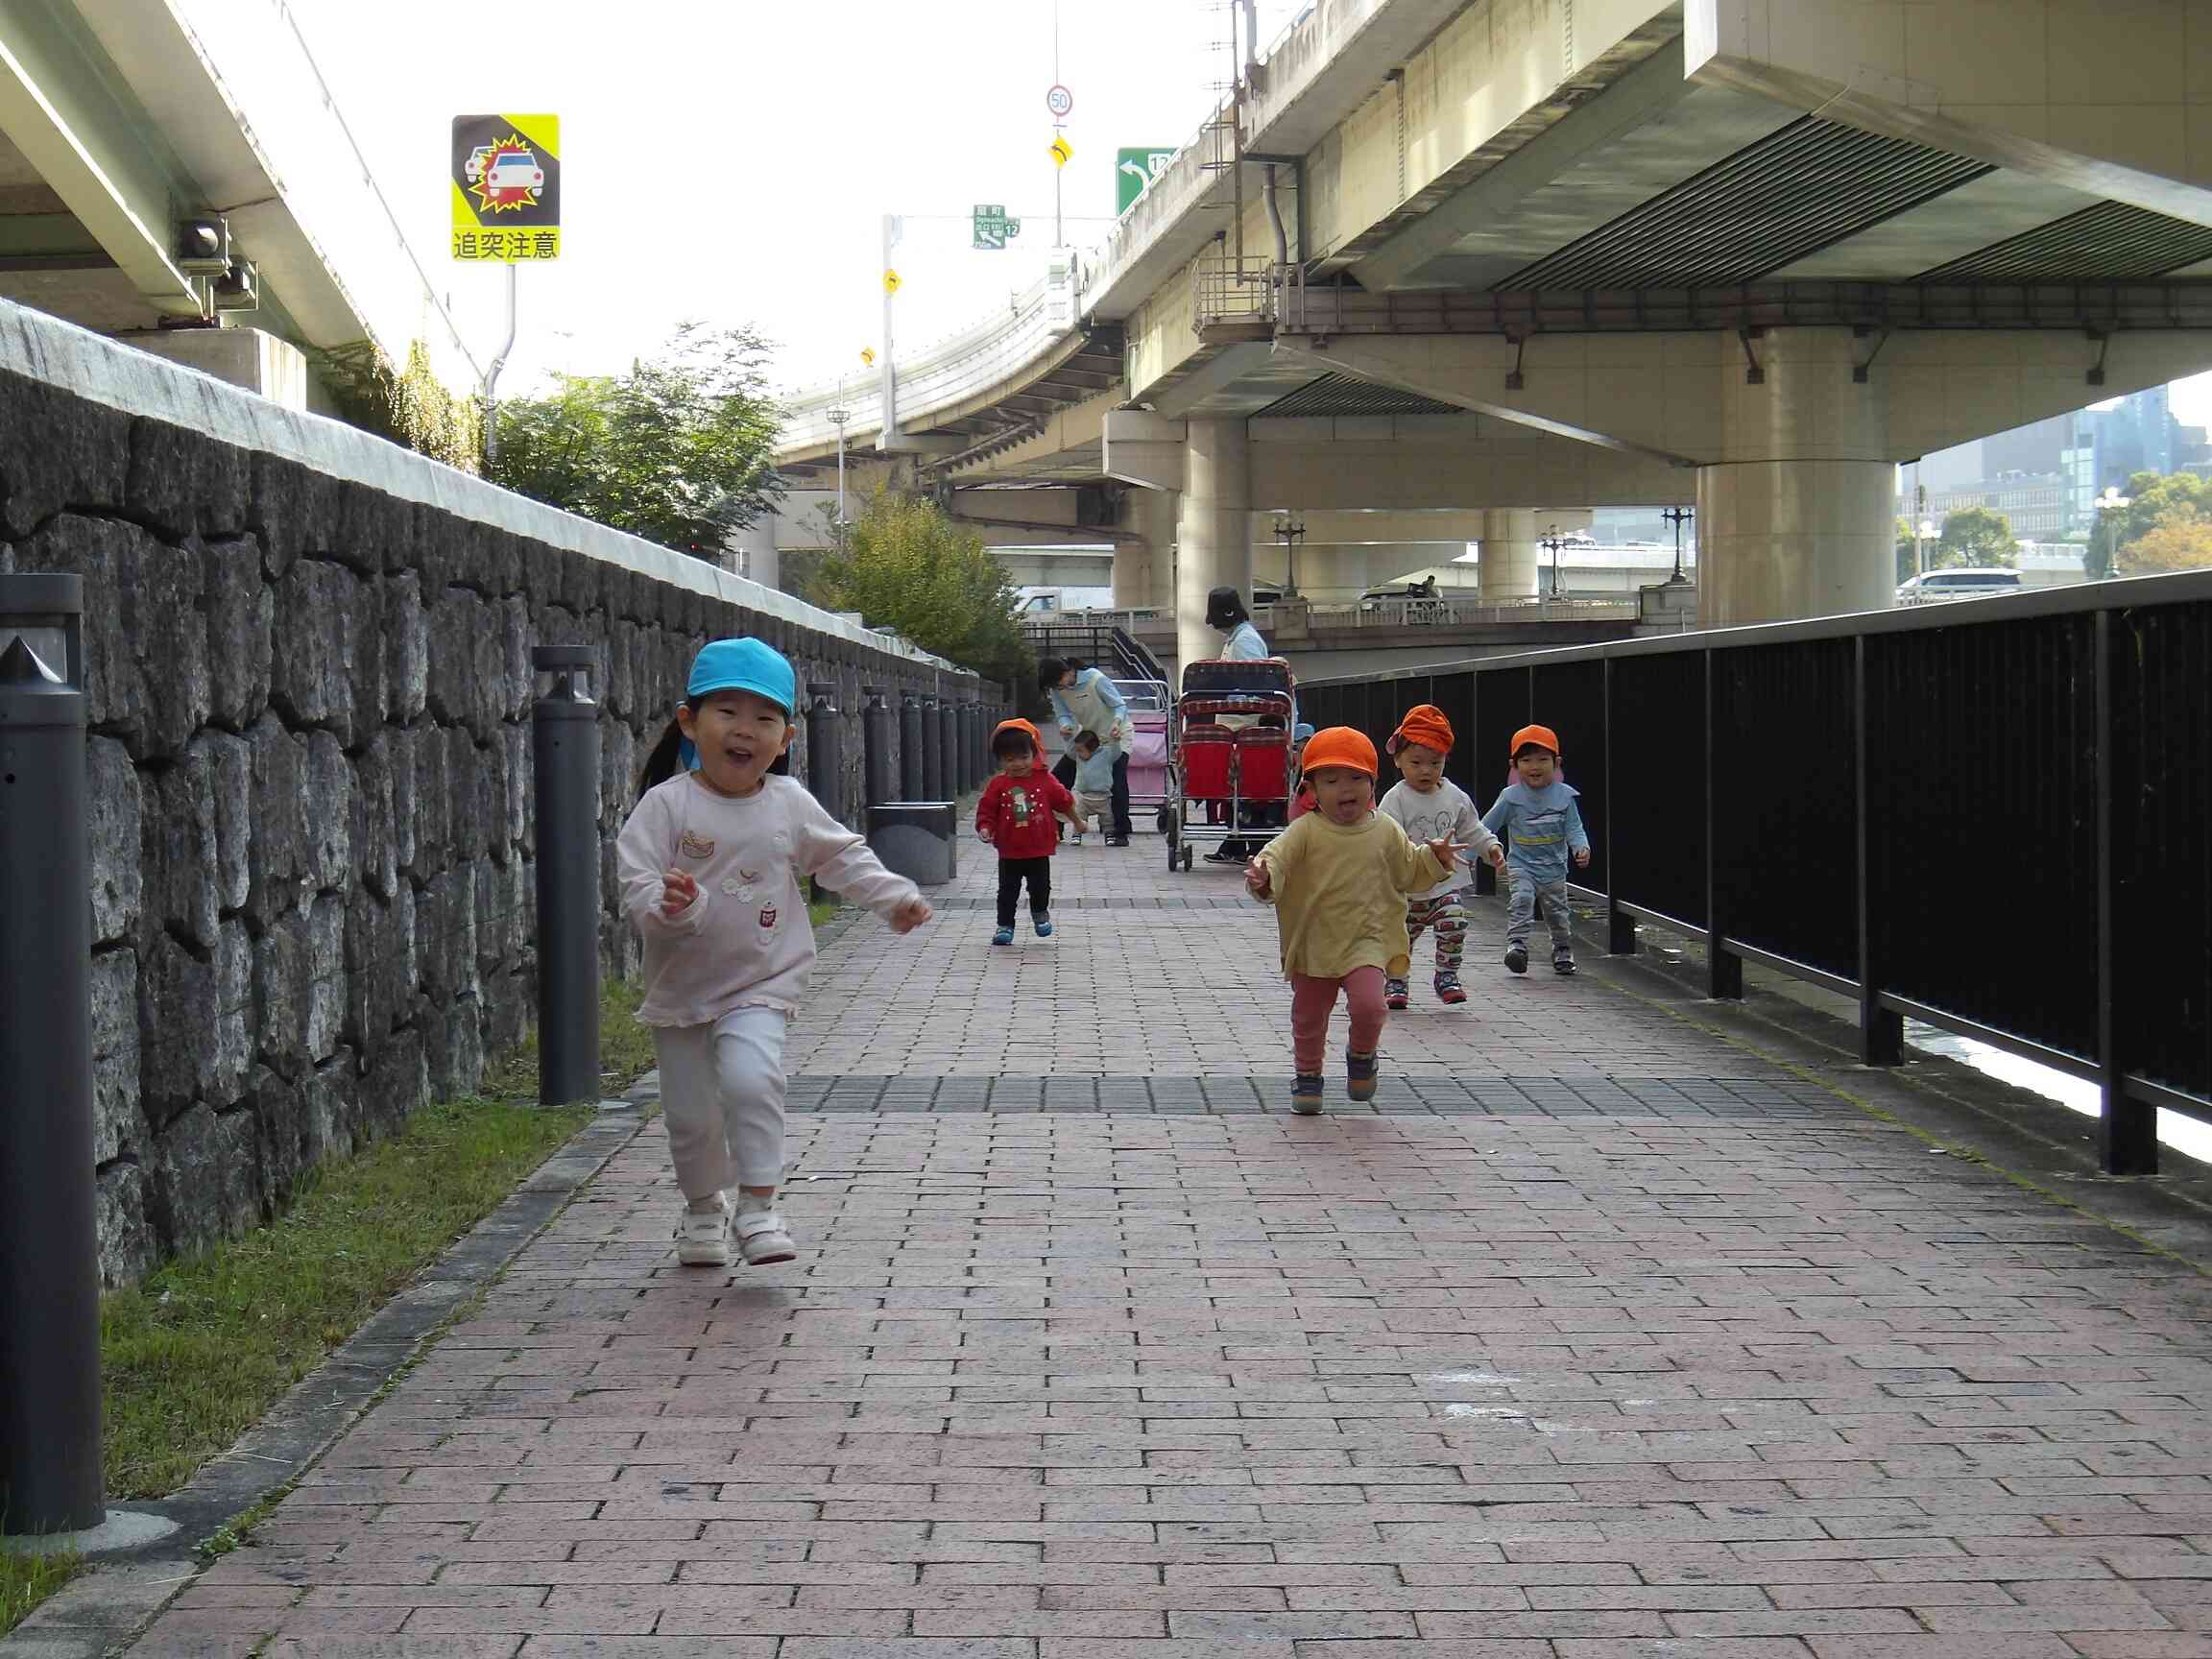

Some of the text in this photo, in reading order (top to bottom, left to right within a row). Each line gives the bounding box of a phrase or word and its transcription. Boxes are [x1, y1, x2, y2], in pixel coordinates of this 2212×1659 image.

[1051, 93, 1068, 108] 50
[453, 231, 558, 259] 追突注意
